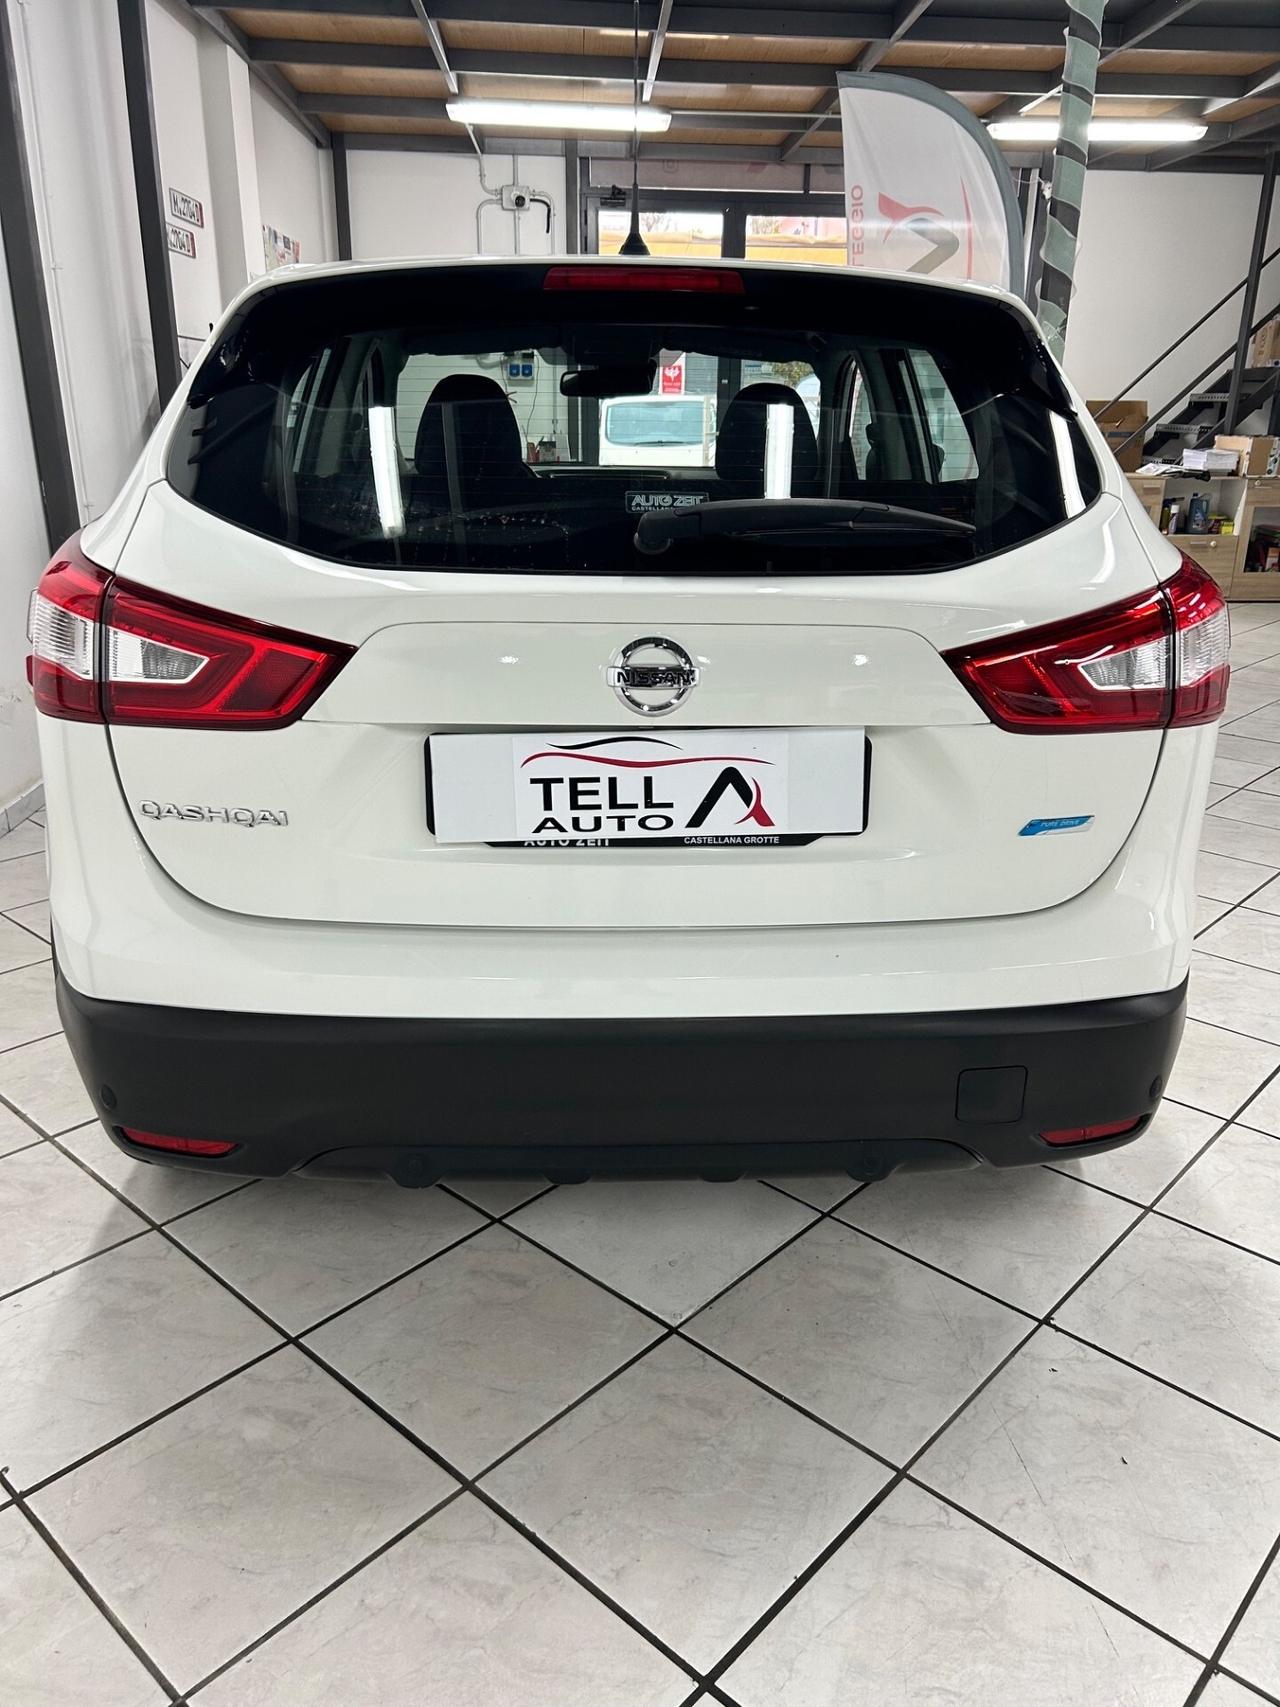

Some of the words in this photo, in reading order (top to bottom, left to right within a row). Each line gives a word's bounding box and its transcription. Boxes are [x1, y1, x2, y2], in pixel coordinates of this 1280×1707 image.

[631, 494, 673, 506] AUTO
[617, 671, 692, 684] NISSAN
[529, 776, 674, 811] TELL
[140, 800, 289, 828] QASHQAI
[531, 814, 674, 833] AUTO
[683, 836, 742, 844] CASTELLANA
[743, 836, 780, 844] GROTTE
